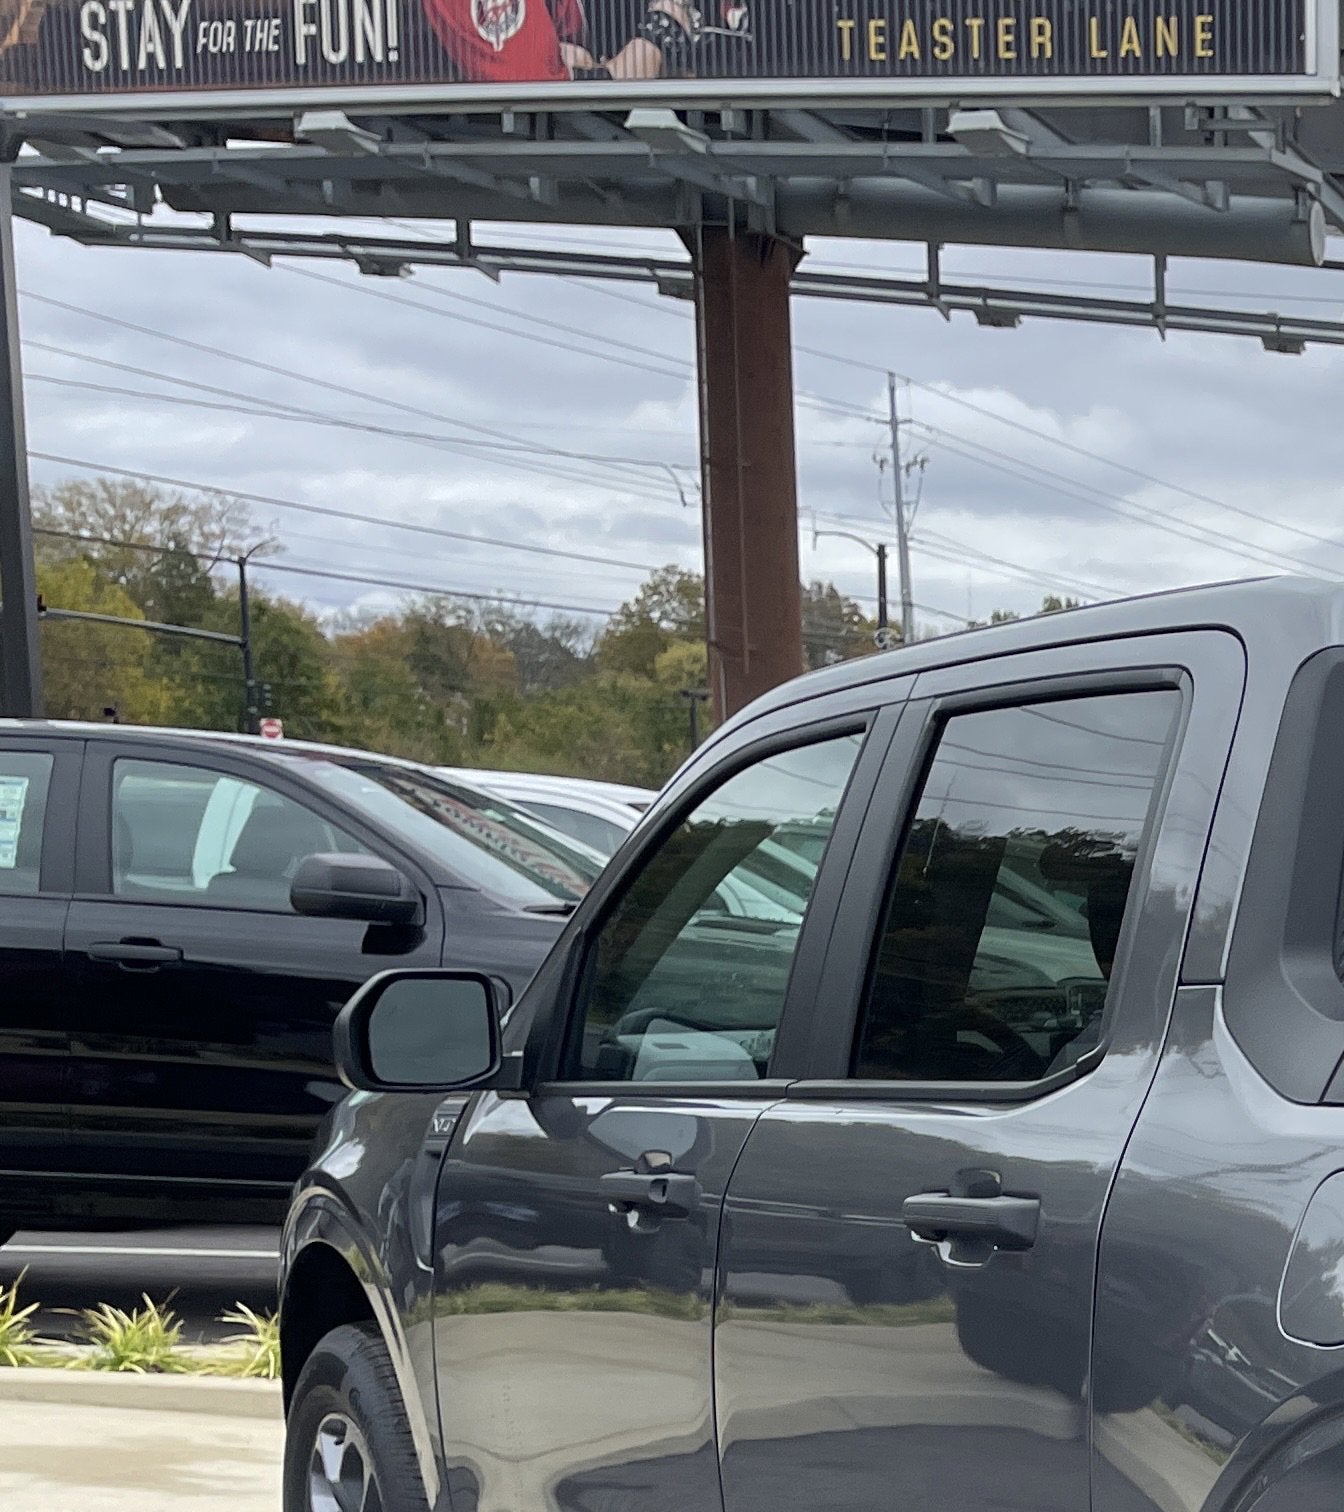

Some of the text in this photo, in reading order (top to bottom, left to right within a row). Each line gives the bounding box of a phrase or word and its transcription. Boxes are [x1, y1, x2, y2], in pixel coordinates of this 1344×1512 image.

[80, 0, 399, 72] STAY FOR THE FUN!
[837, 14, 1214, 61] TEASTER LANE
